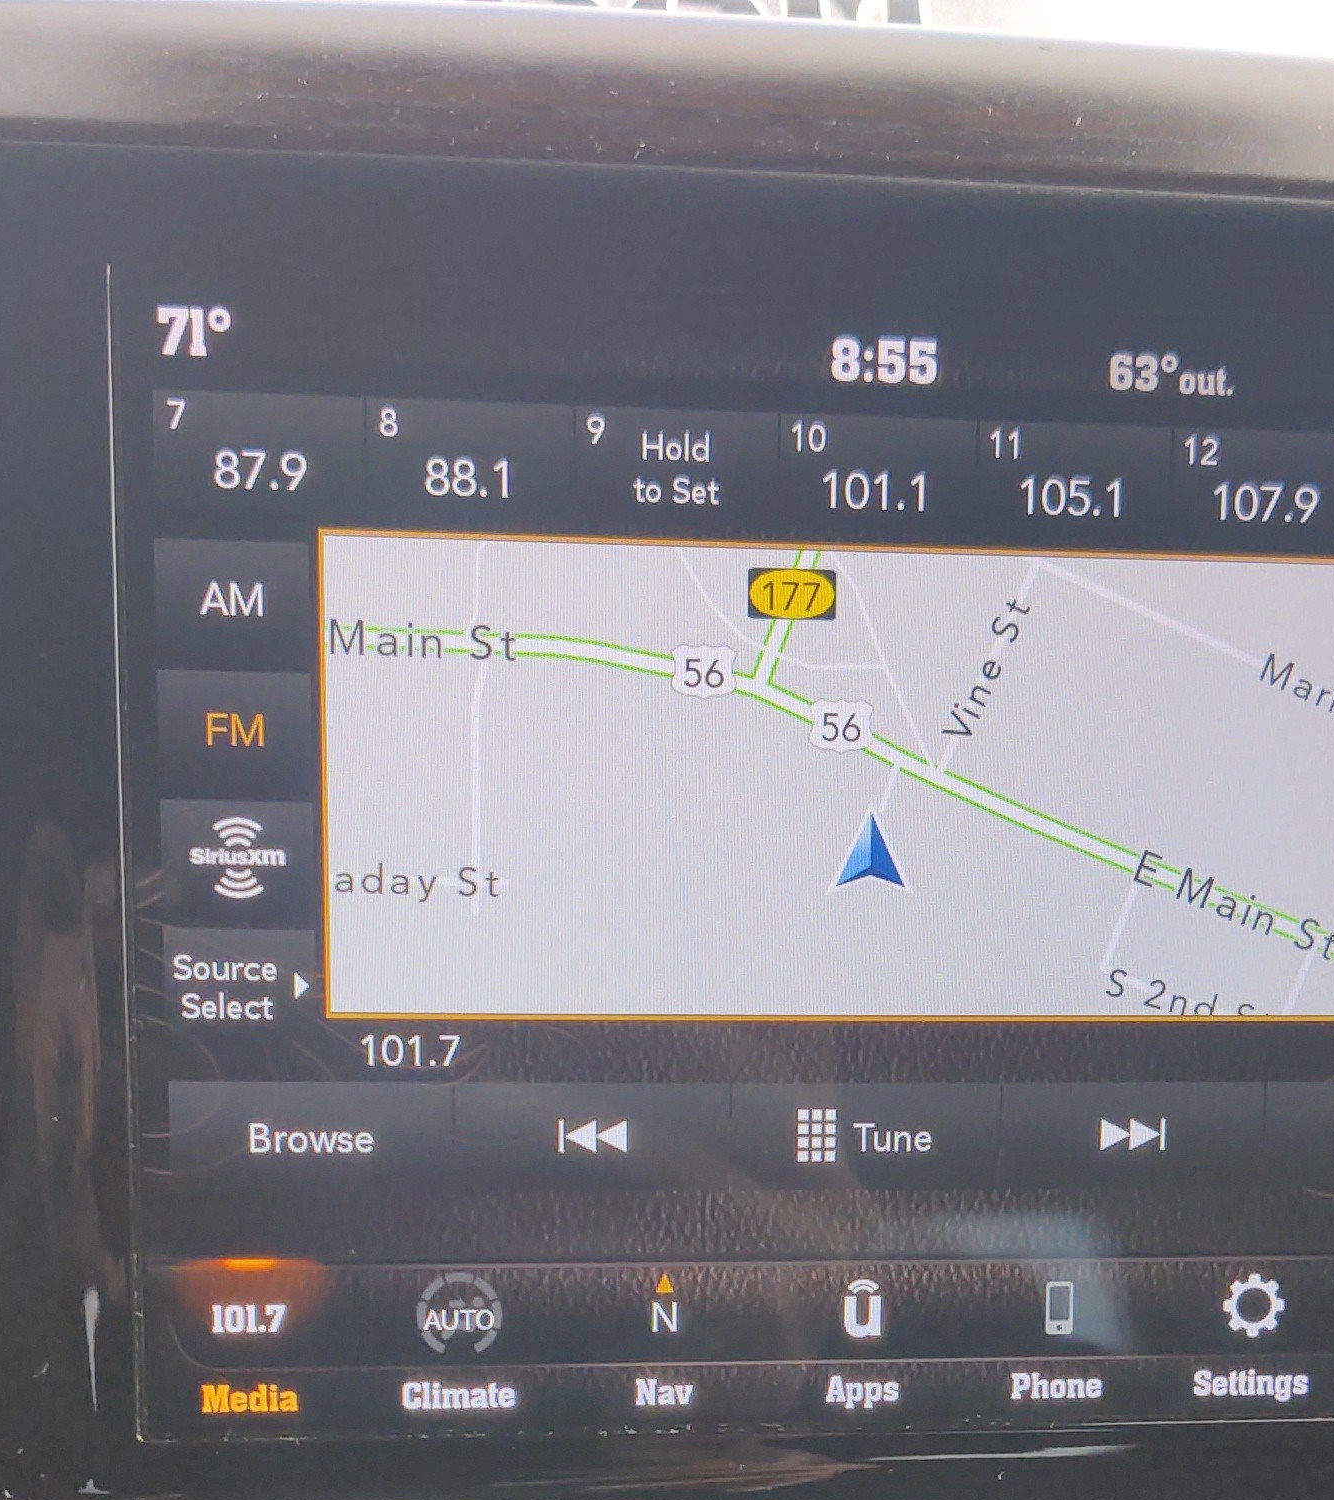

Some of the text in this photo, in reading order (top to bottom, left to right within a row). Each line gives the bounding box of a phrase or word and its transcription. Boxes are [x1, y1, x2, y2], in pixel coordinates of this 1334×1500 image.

[157, 305, 232, 357] 71°
[830, 334, 939, 386] 8:55
[166, 398, 186, 430] 7
[379, 408, 399, 438] 8
[586, 414, 606, 445] 9
[640, 430, 711, 463] Hold
[790, 421, 827, 453] 10
[988, 428, 1020, 460] 11
[1184, 434, 1220, 466] 12
[214, 448, 308, 491] 87.9
[424, 456, 511, 499] 88.1
[633, 477, 720, 506] to Set
[822, 469, 927, 513] 101.1
[1019, 475, 1123, 518] 105.1
[1213, 483, 1320, 524] 107.9
[199, 581, 265, 617] AM
[762, 580, 822, 612] 177
[329, 619, 517, 662] Main St
[684, 658, 725, 688] 56
[941, 599, 1031, 739] Vine St
[205, 713, 266, 747] FM
[821, 712, 861, 743] 56
[458, 867, 500, 898] St
[1133, 850, 1163, 888] E
[1176, 867, 1274, 935] Main
[172, 954, 278, 982] Source
[181, 993, 274, 1020] Select
[1106, 969, 1127, 997] S
[1144, 979, 1218, 1015] 2nd
[361, 1034, 461, 1067] 101.7
[248, 1122, 375, 1155] Browse
[853, 1122, 933, 1154] Tune
[211, 1304, 288, 1334] 101.7
[423, 1309, 496, 1331] AUTO
[651, 1301, 679, 1333] N
[200, 1383, 299, 1414] Media
[402, 1382, 517, 1410] Climate
[635, 1379, 695, 1407] Nav
[825, 1375, 899, 1409] Apps
[1010, 1372, 1104, 1400] Phone
[1193, 1370, 1310, 1402] Settings
